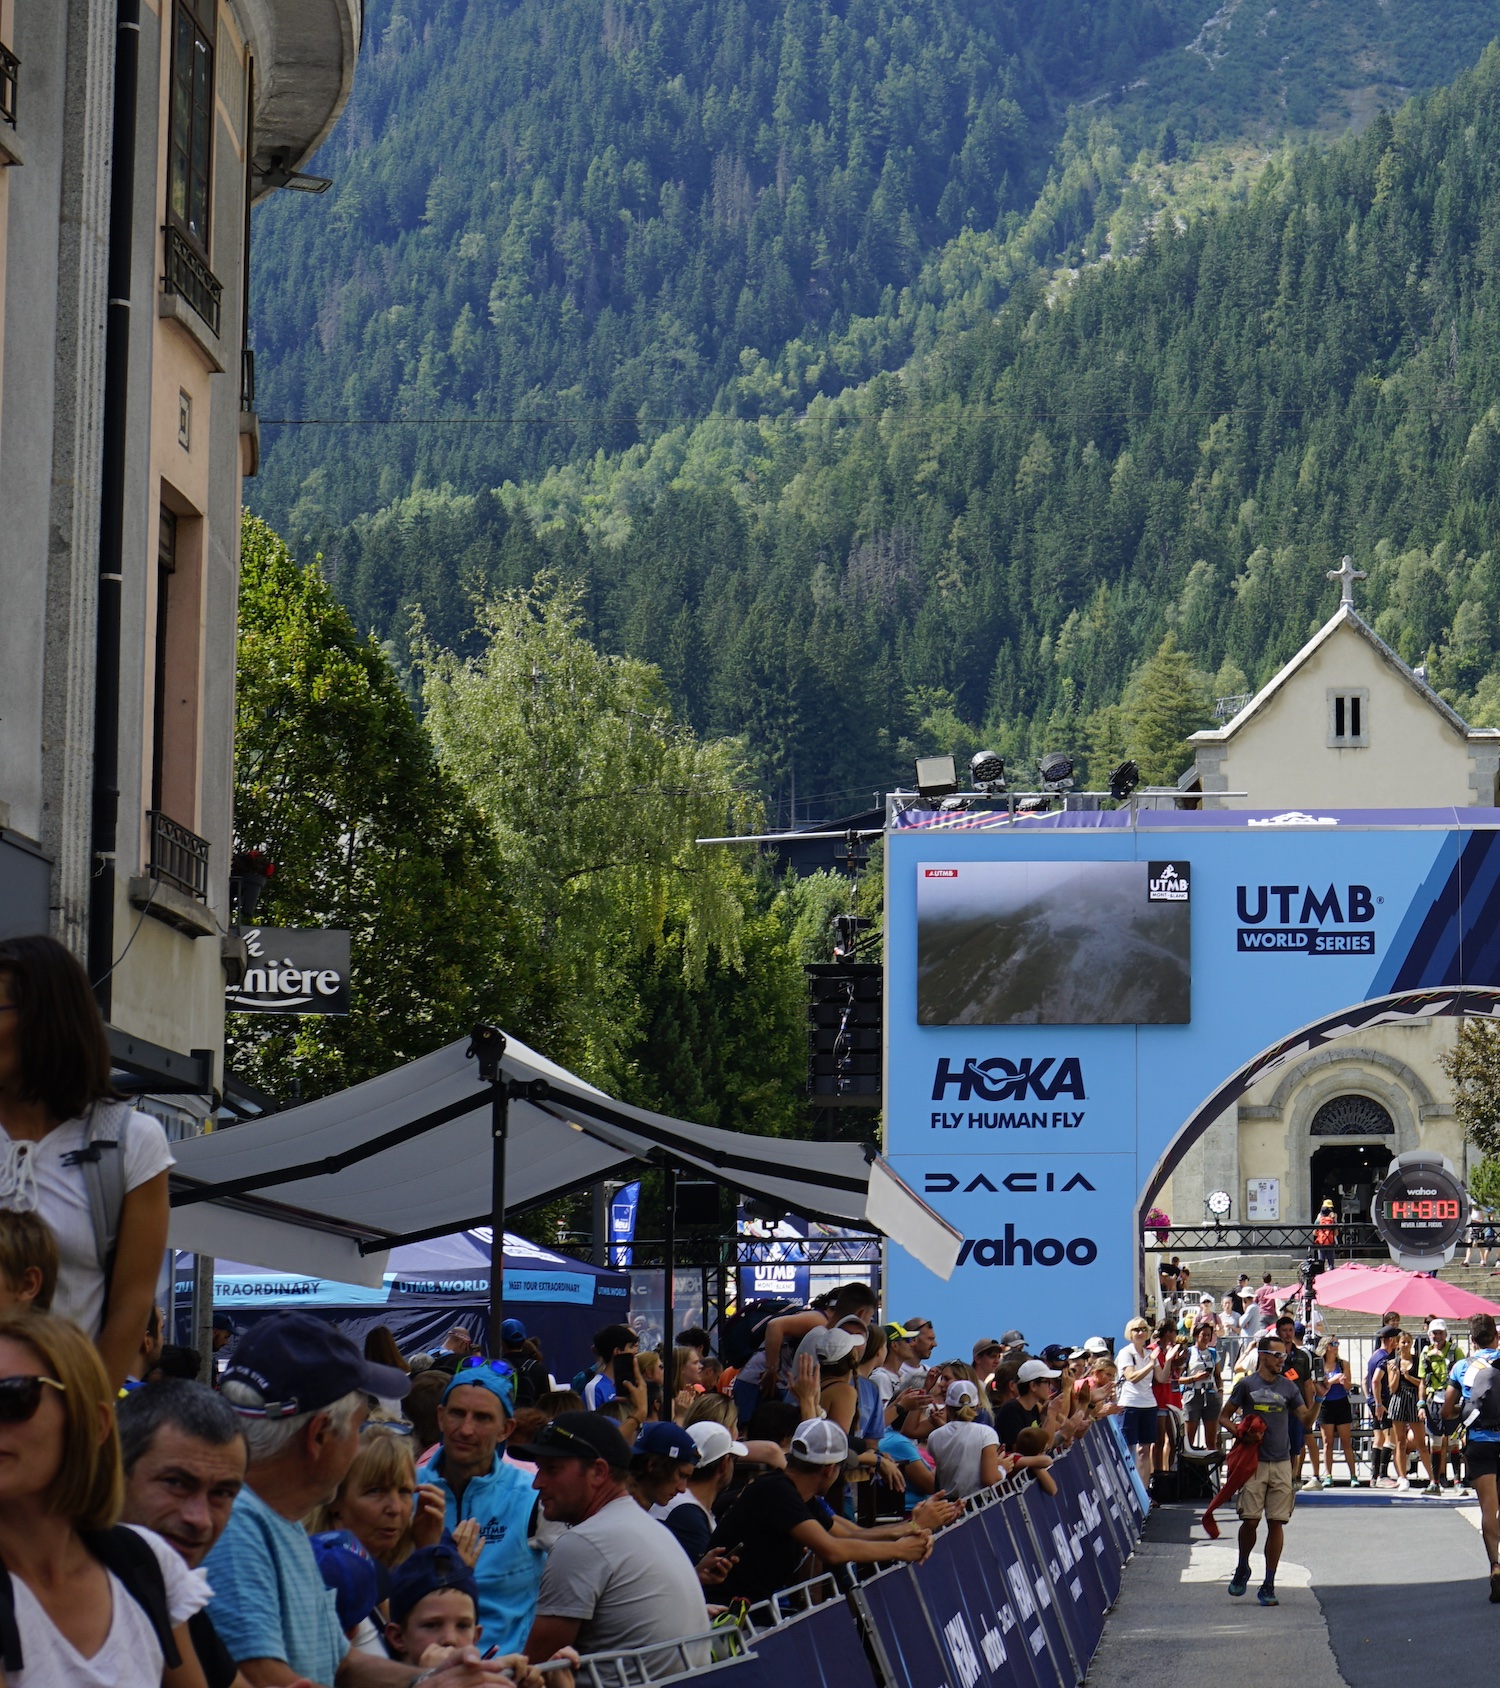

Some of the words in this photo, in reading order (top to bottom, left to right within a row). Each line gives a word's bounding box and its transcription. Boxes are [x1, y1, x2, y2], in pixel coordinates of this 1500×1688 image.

[1150, 879, 1187, 891] UTMB
[1237, 883, 1375, 924] UTMB
[1243, 932, 1309, 949] WORLD
[1315, 934, 1371, 951] SERIES
[226, 957, 341, 996] nière
[931, 1057, 1087, 1101] HOKA
[931, 1112, 964, 1129] FLY
[968, 1112, 1049, 1128] HUMAN
[1052, 1112, 1086, 1128] FLY
[925, 1172, 1097, 1192] DACIA
[1407, 1187, 1437, 1196] wahoo
[1391, 1200, 1458, 1219] 14:43:03
[755, 1265, 795, 1280] UTMB
[213, 1282, 321, 1296] TRAORDINARY
[509, 1281, 521, 1290] MEET
[523, 1281, 537, 1290] YOUR
[538, 1281, 580, 1293] EXTRAORDINARY
